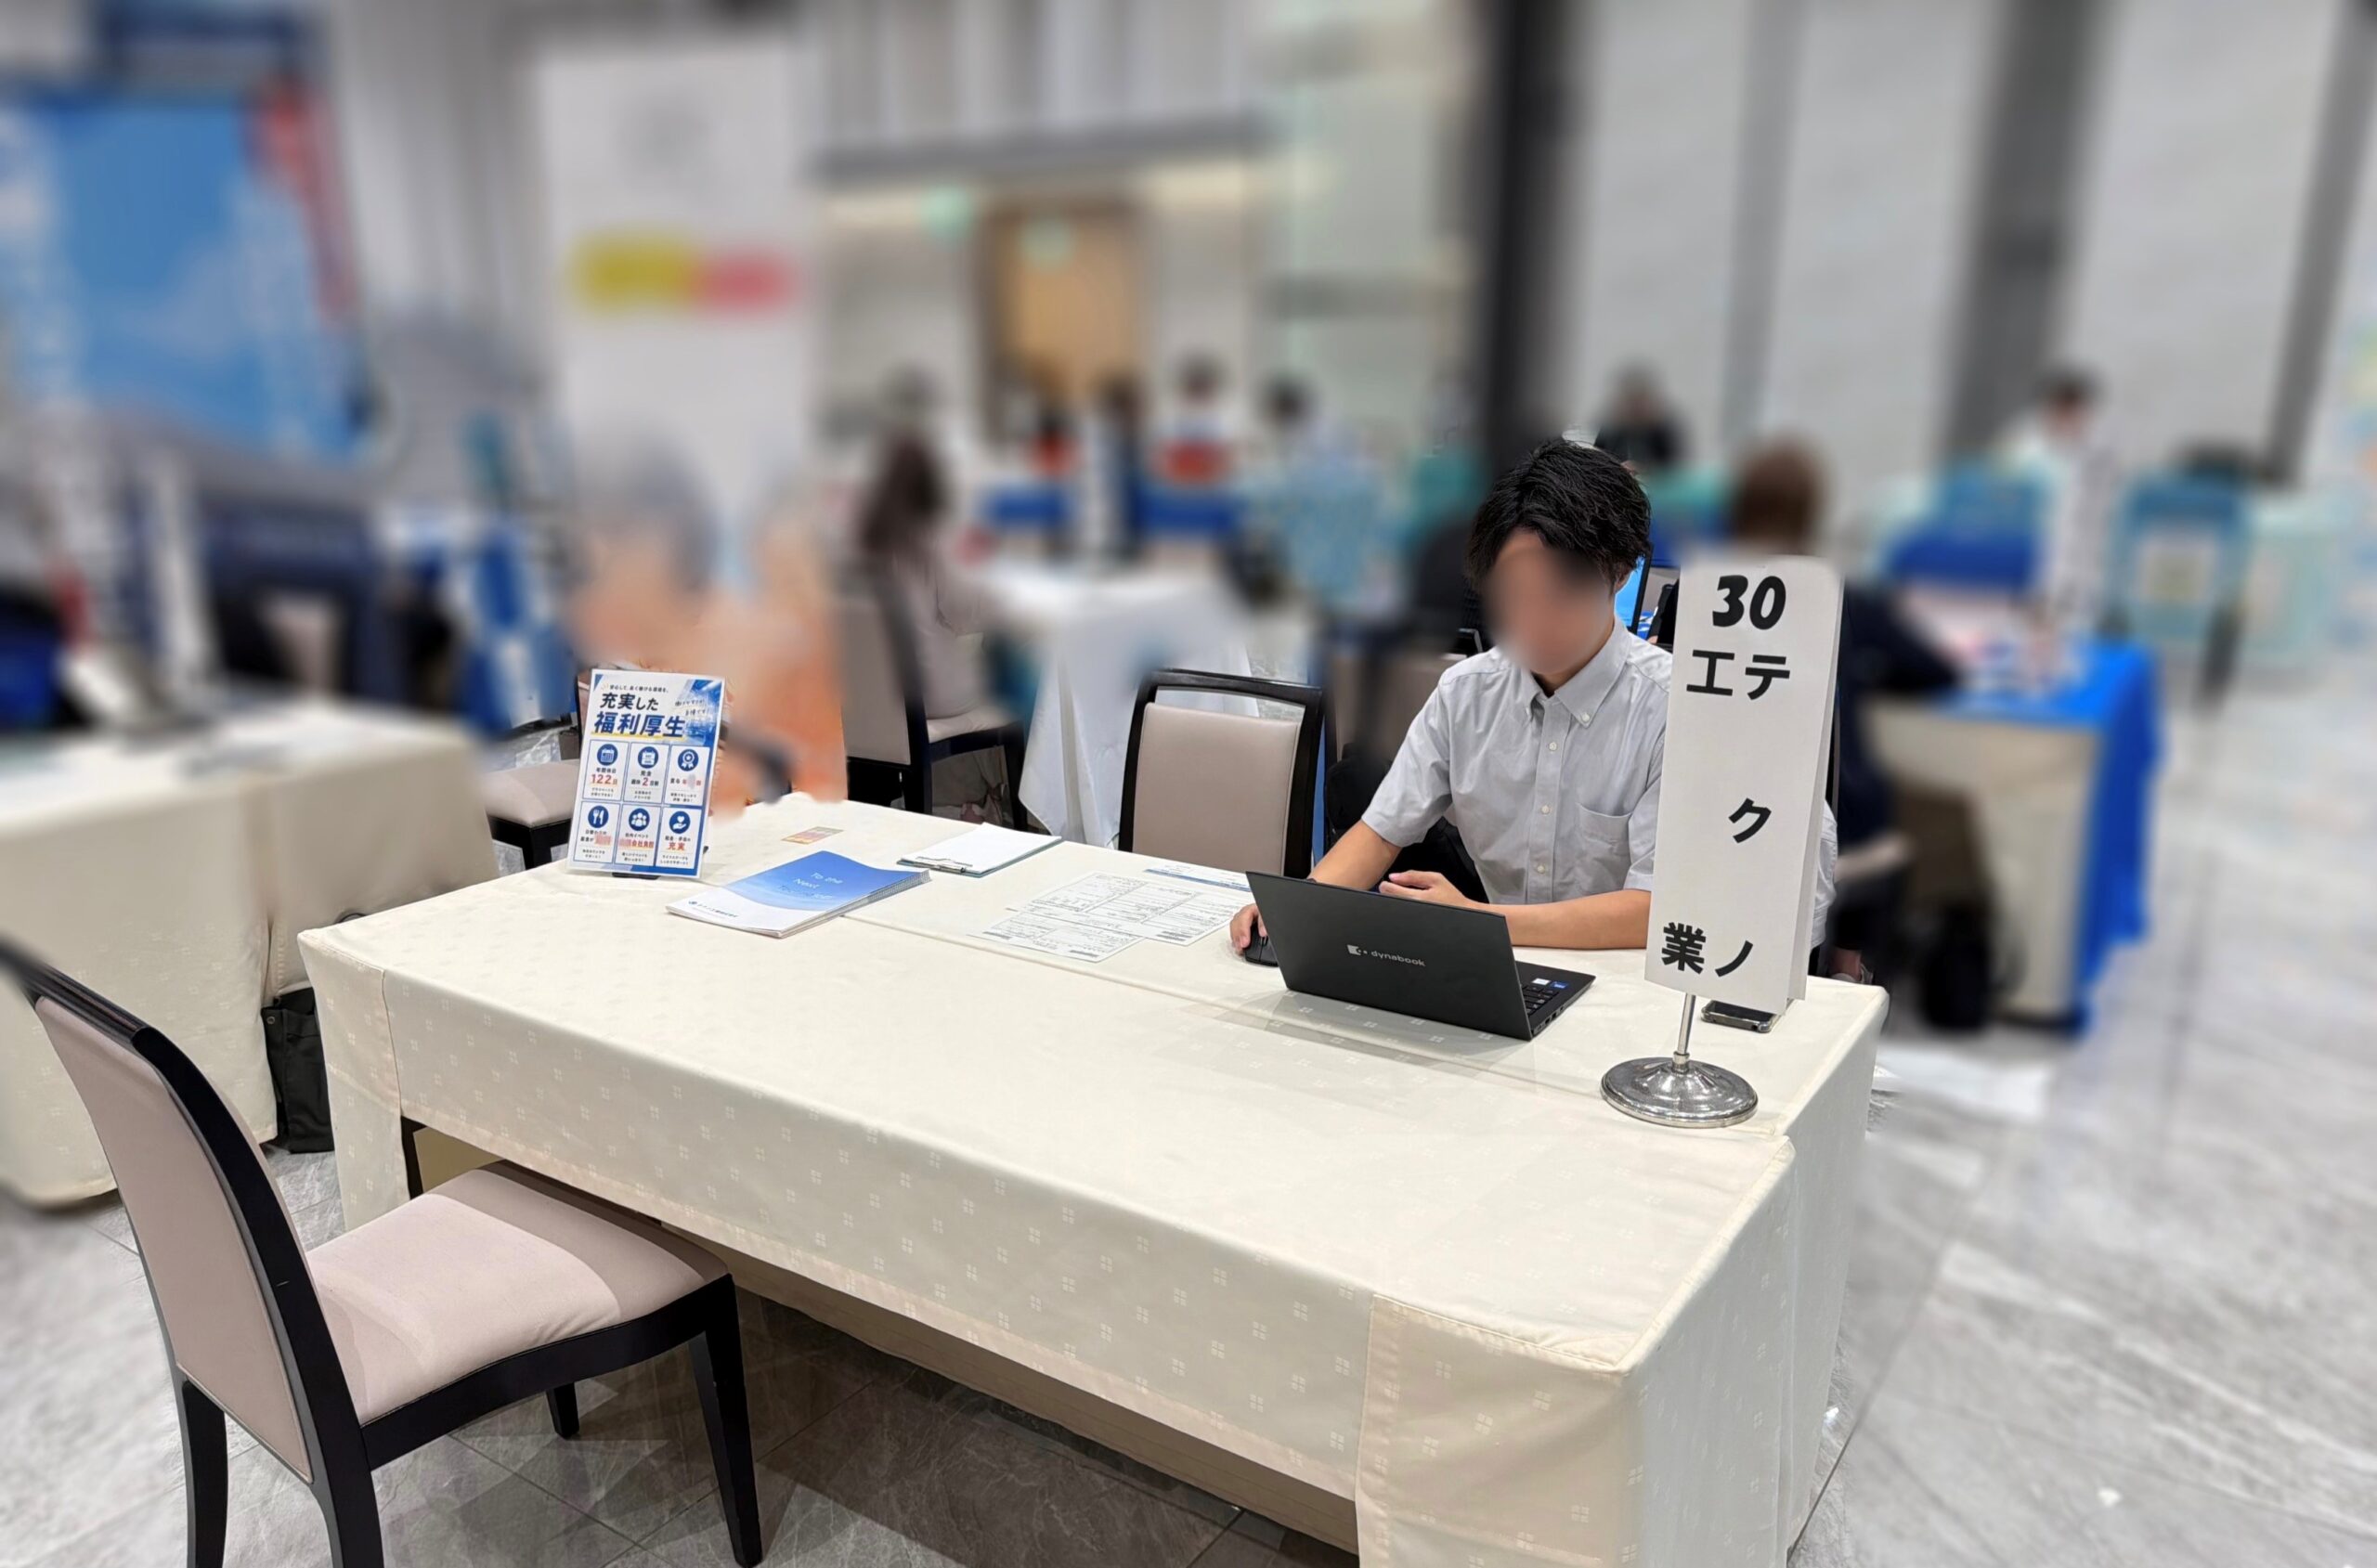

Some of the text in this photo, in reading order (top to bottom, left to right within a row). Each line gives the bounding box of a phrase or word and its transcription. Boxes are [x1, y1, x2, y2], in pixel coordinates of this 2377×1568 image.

[1712, 575, 1786, 630] 30
[600, 692, 659, 711] 充実した
[593, 710, 686, 738] 福利厚生
[1660, 649, 1735, 975] 工業
[1714, 654, 1791, 978] テクノ
[668, 841, 685, 850] 充実
[1370, 950, 1426, 967] dynabook
